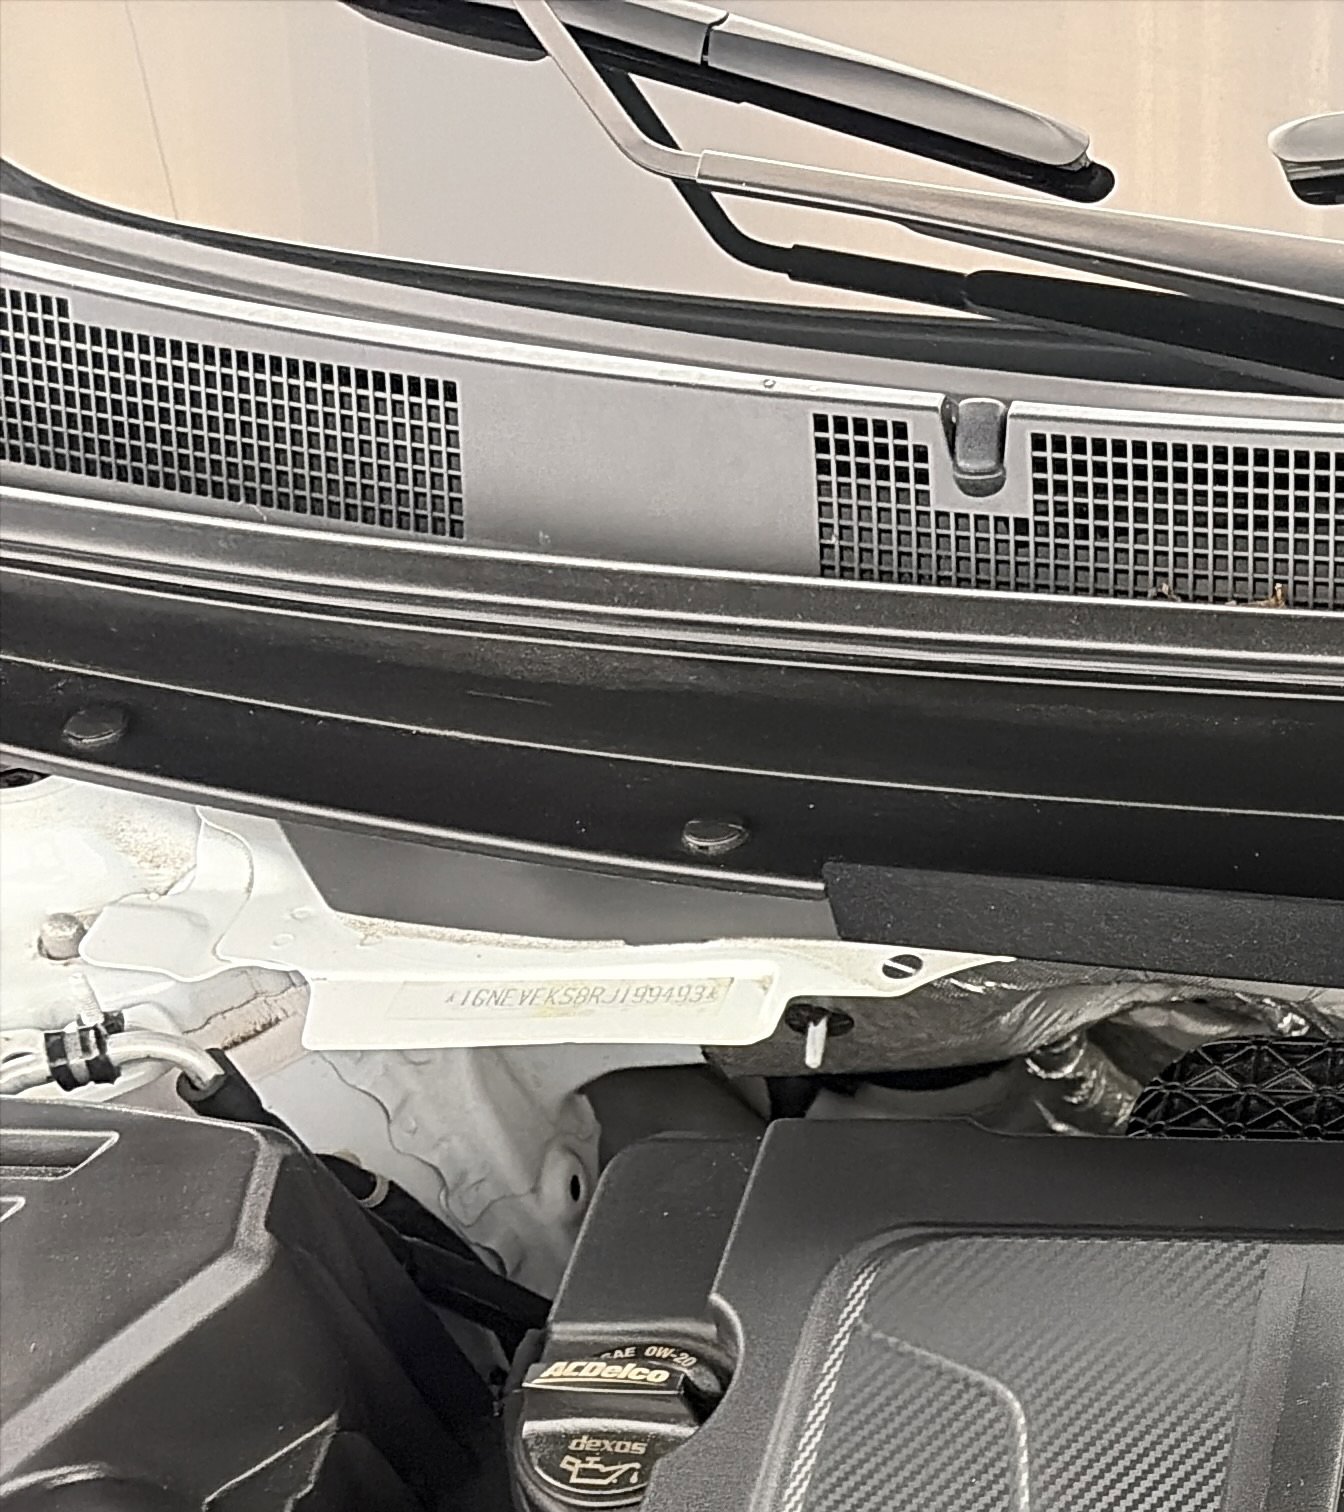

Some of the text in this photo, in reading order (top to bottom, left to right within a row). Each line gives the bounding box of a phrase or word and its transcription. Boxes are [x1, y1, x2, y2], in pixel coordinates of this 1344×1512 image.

[644, 1345, 698, 1368] 0W-20
[540, 1361, 671, 1384] ACDelco
[568, 1434, 649, 1455] dexos
